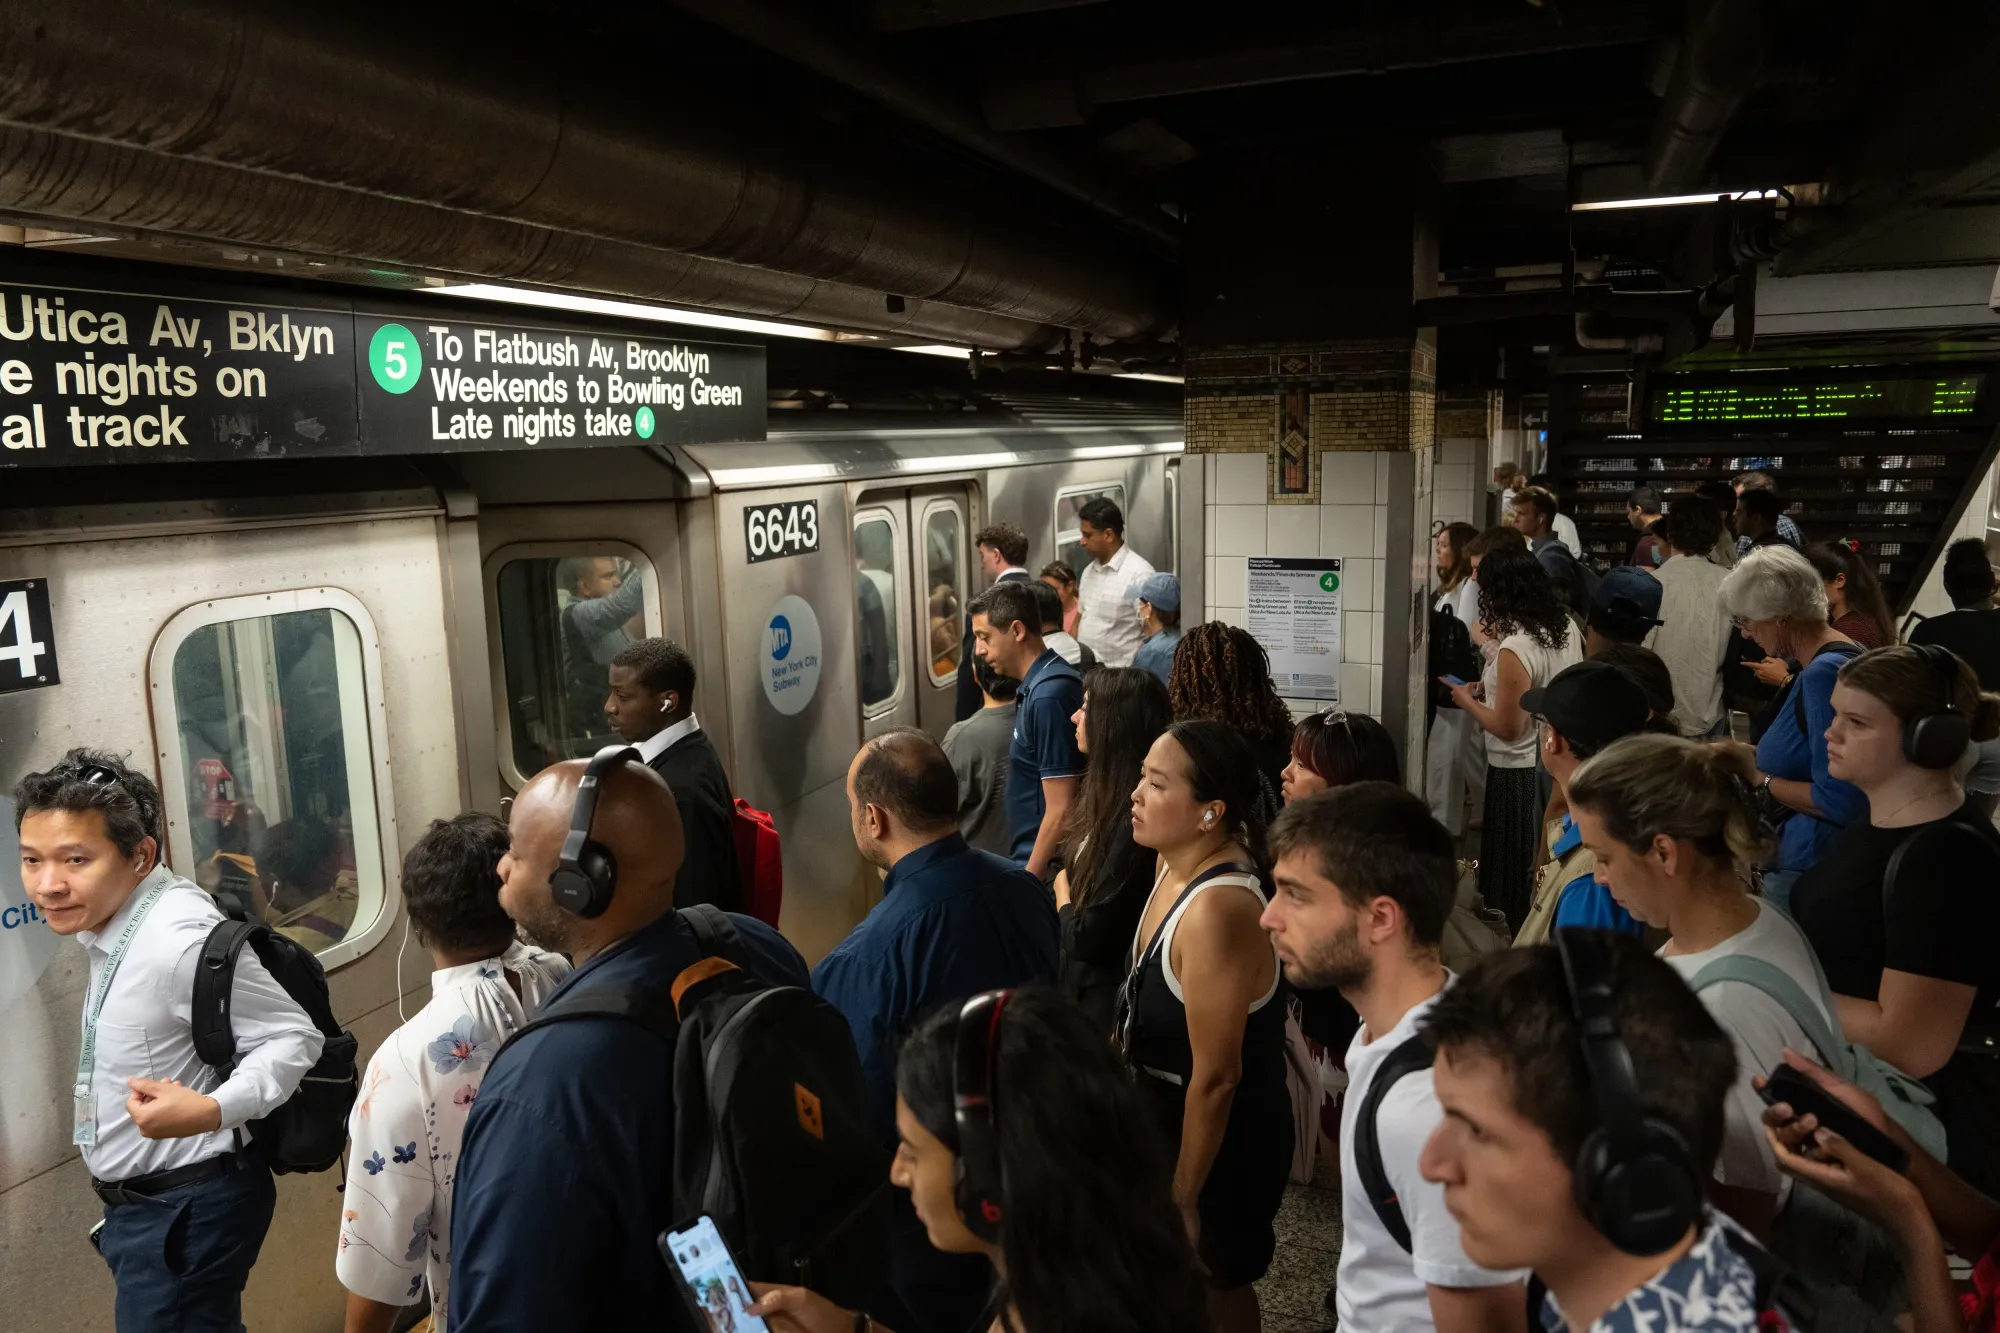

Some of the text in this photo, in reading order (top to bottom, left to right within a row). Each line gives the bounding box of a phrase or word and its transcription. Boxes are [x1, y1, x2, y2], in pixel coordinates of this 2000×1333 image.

[0, 293, 334, 361] Utica Av, Bklyn
[385, 341, 408, 380] 5
[428, 325, 709, 378] To Flatbush Av, Brooklyn
[0, 351, 266, 406] e nights on
[430, 367, 742, 411] Weekends to Bowling Green
[2, 403, 189, 449] al track
[431, 406, 650, 445] Late nights take 4
[748, 504, 818, 556] 6643
[1325, 577, 1333, 587] 4
[0, 590, 46, 679] 4
[770, 627, 789, 653] MTA
[772, 655, 818, 680] New York City
[772, 676, 801, 693] Subway
[199, 765, 222, 776] STOP
[2, 902, 47, 929] Cit
[82, 1023, 95, 1067] TEAMWORK
[123, 900, 150, 938] DECISION
